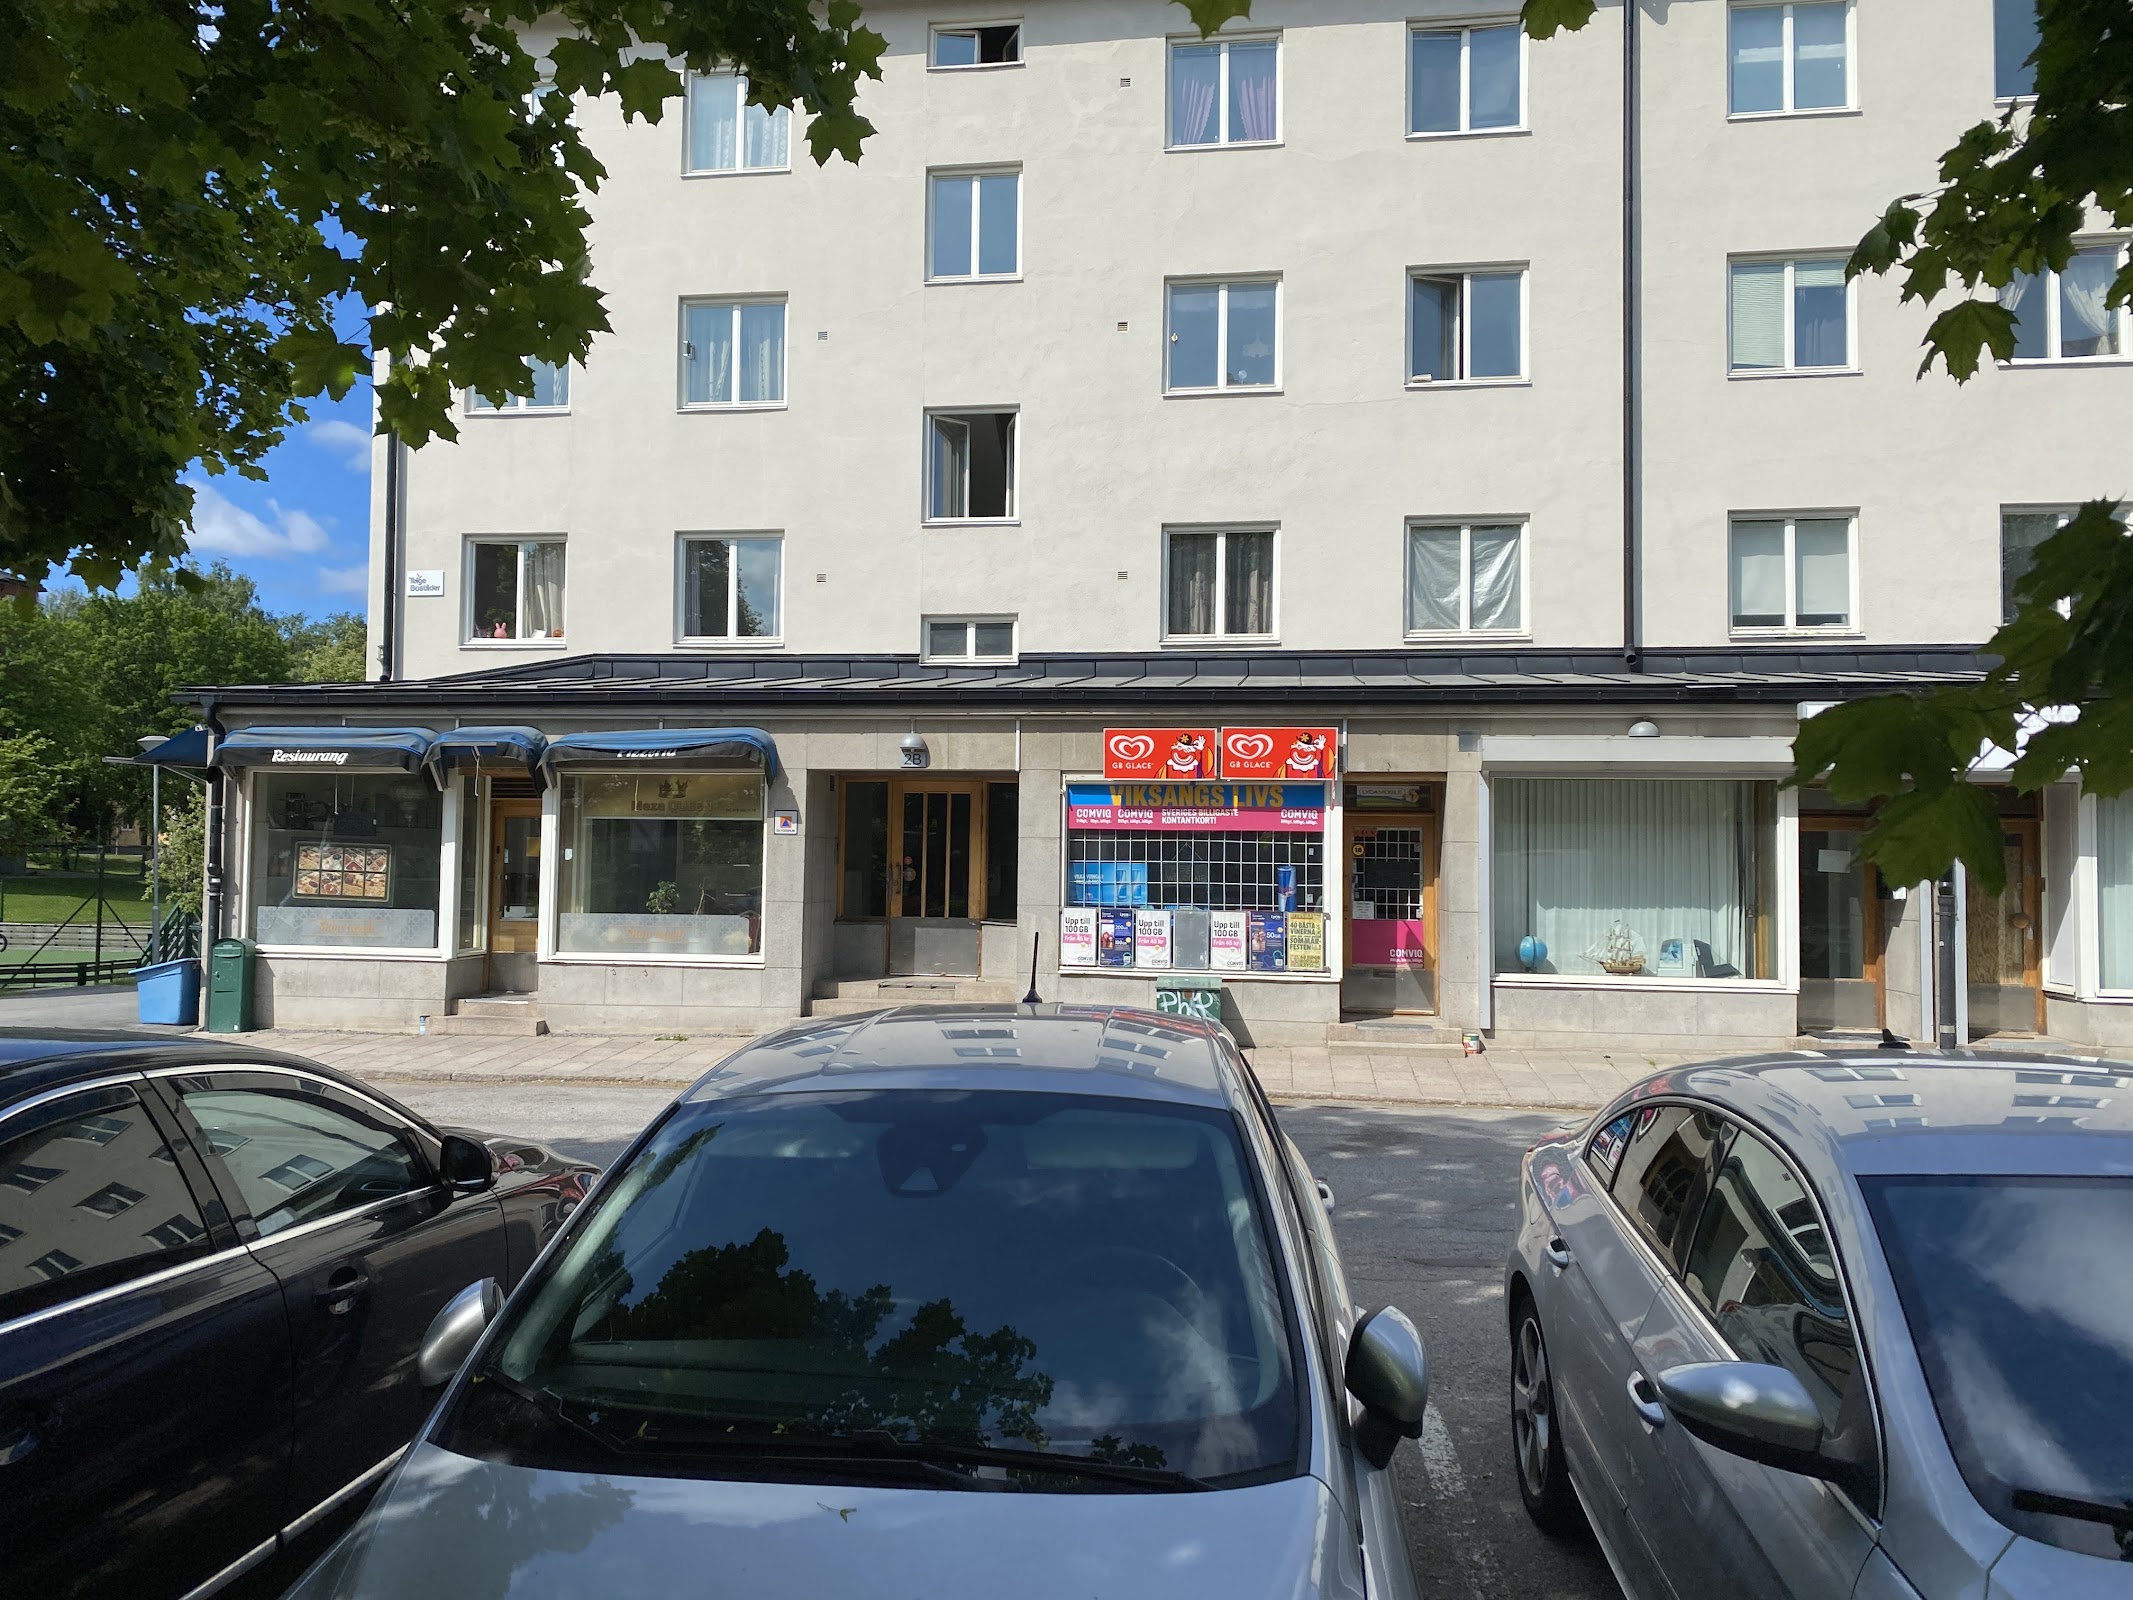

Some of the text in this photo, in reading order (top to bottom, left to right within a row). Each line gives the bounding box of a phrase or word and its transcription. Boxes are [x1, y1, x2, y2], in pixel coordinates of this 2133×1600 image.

[1112, 761, 1152, 769] GB GLACE
[1230, 761, 1270, 769] GB GLACE
[1232, 785, 1284, 807] LIVS
[1076, 808, 1112, 818] COMVIQ
[1118, 809, 1153, 818] COMVIQ
[1161, 809, 1239, 817] SVERIGES BILLIGASTE
[1281, 809, 1318, 819] COMVIQ
[1066, 917, 1079, 925] Upp
[1139, 920, 1153, 928] Upp
[1214, 921, 1228, 930] Upp
[1152, 928, 1163, 936] GB
[1389, 948, 1423, 958] COMVIQ
